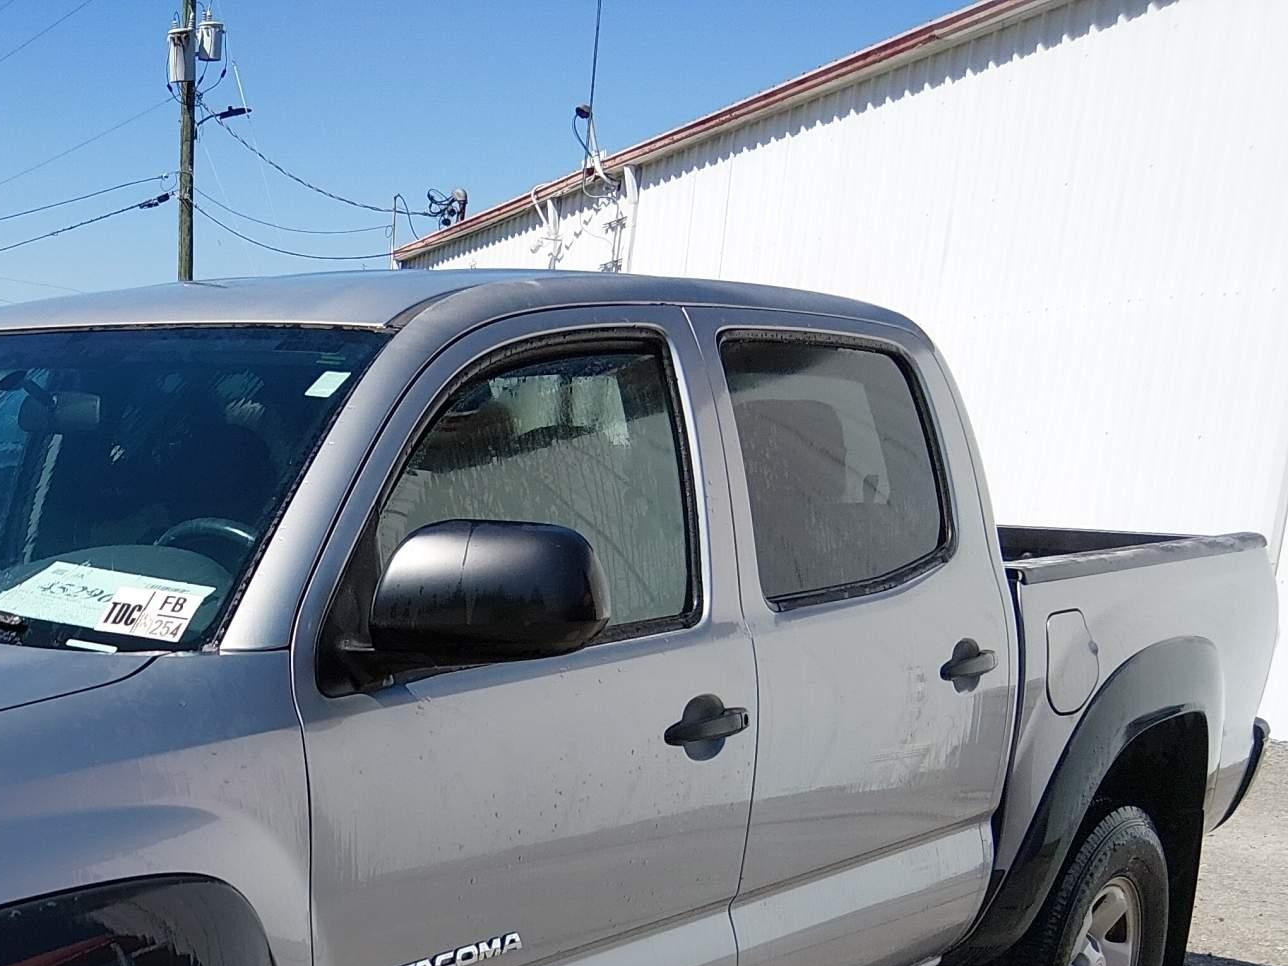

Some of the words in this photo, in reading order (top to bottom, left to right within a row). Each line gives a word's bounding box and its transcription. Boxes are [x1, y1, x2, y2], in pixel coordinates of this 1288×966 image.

[159, 596, 187, 612] FB
[103, 602, 143, 626] TDC
[150, 620, 182, 638] 254
